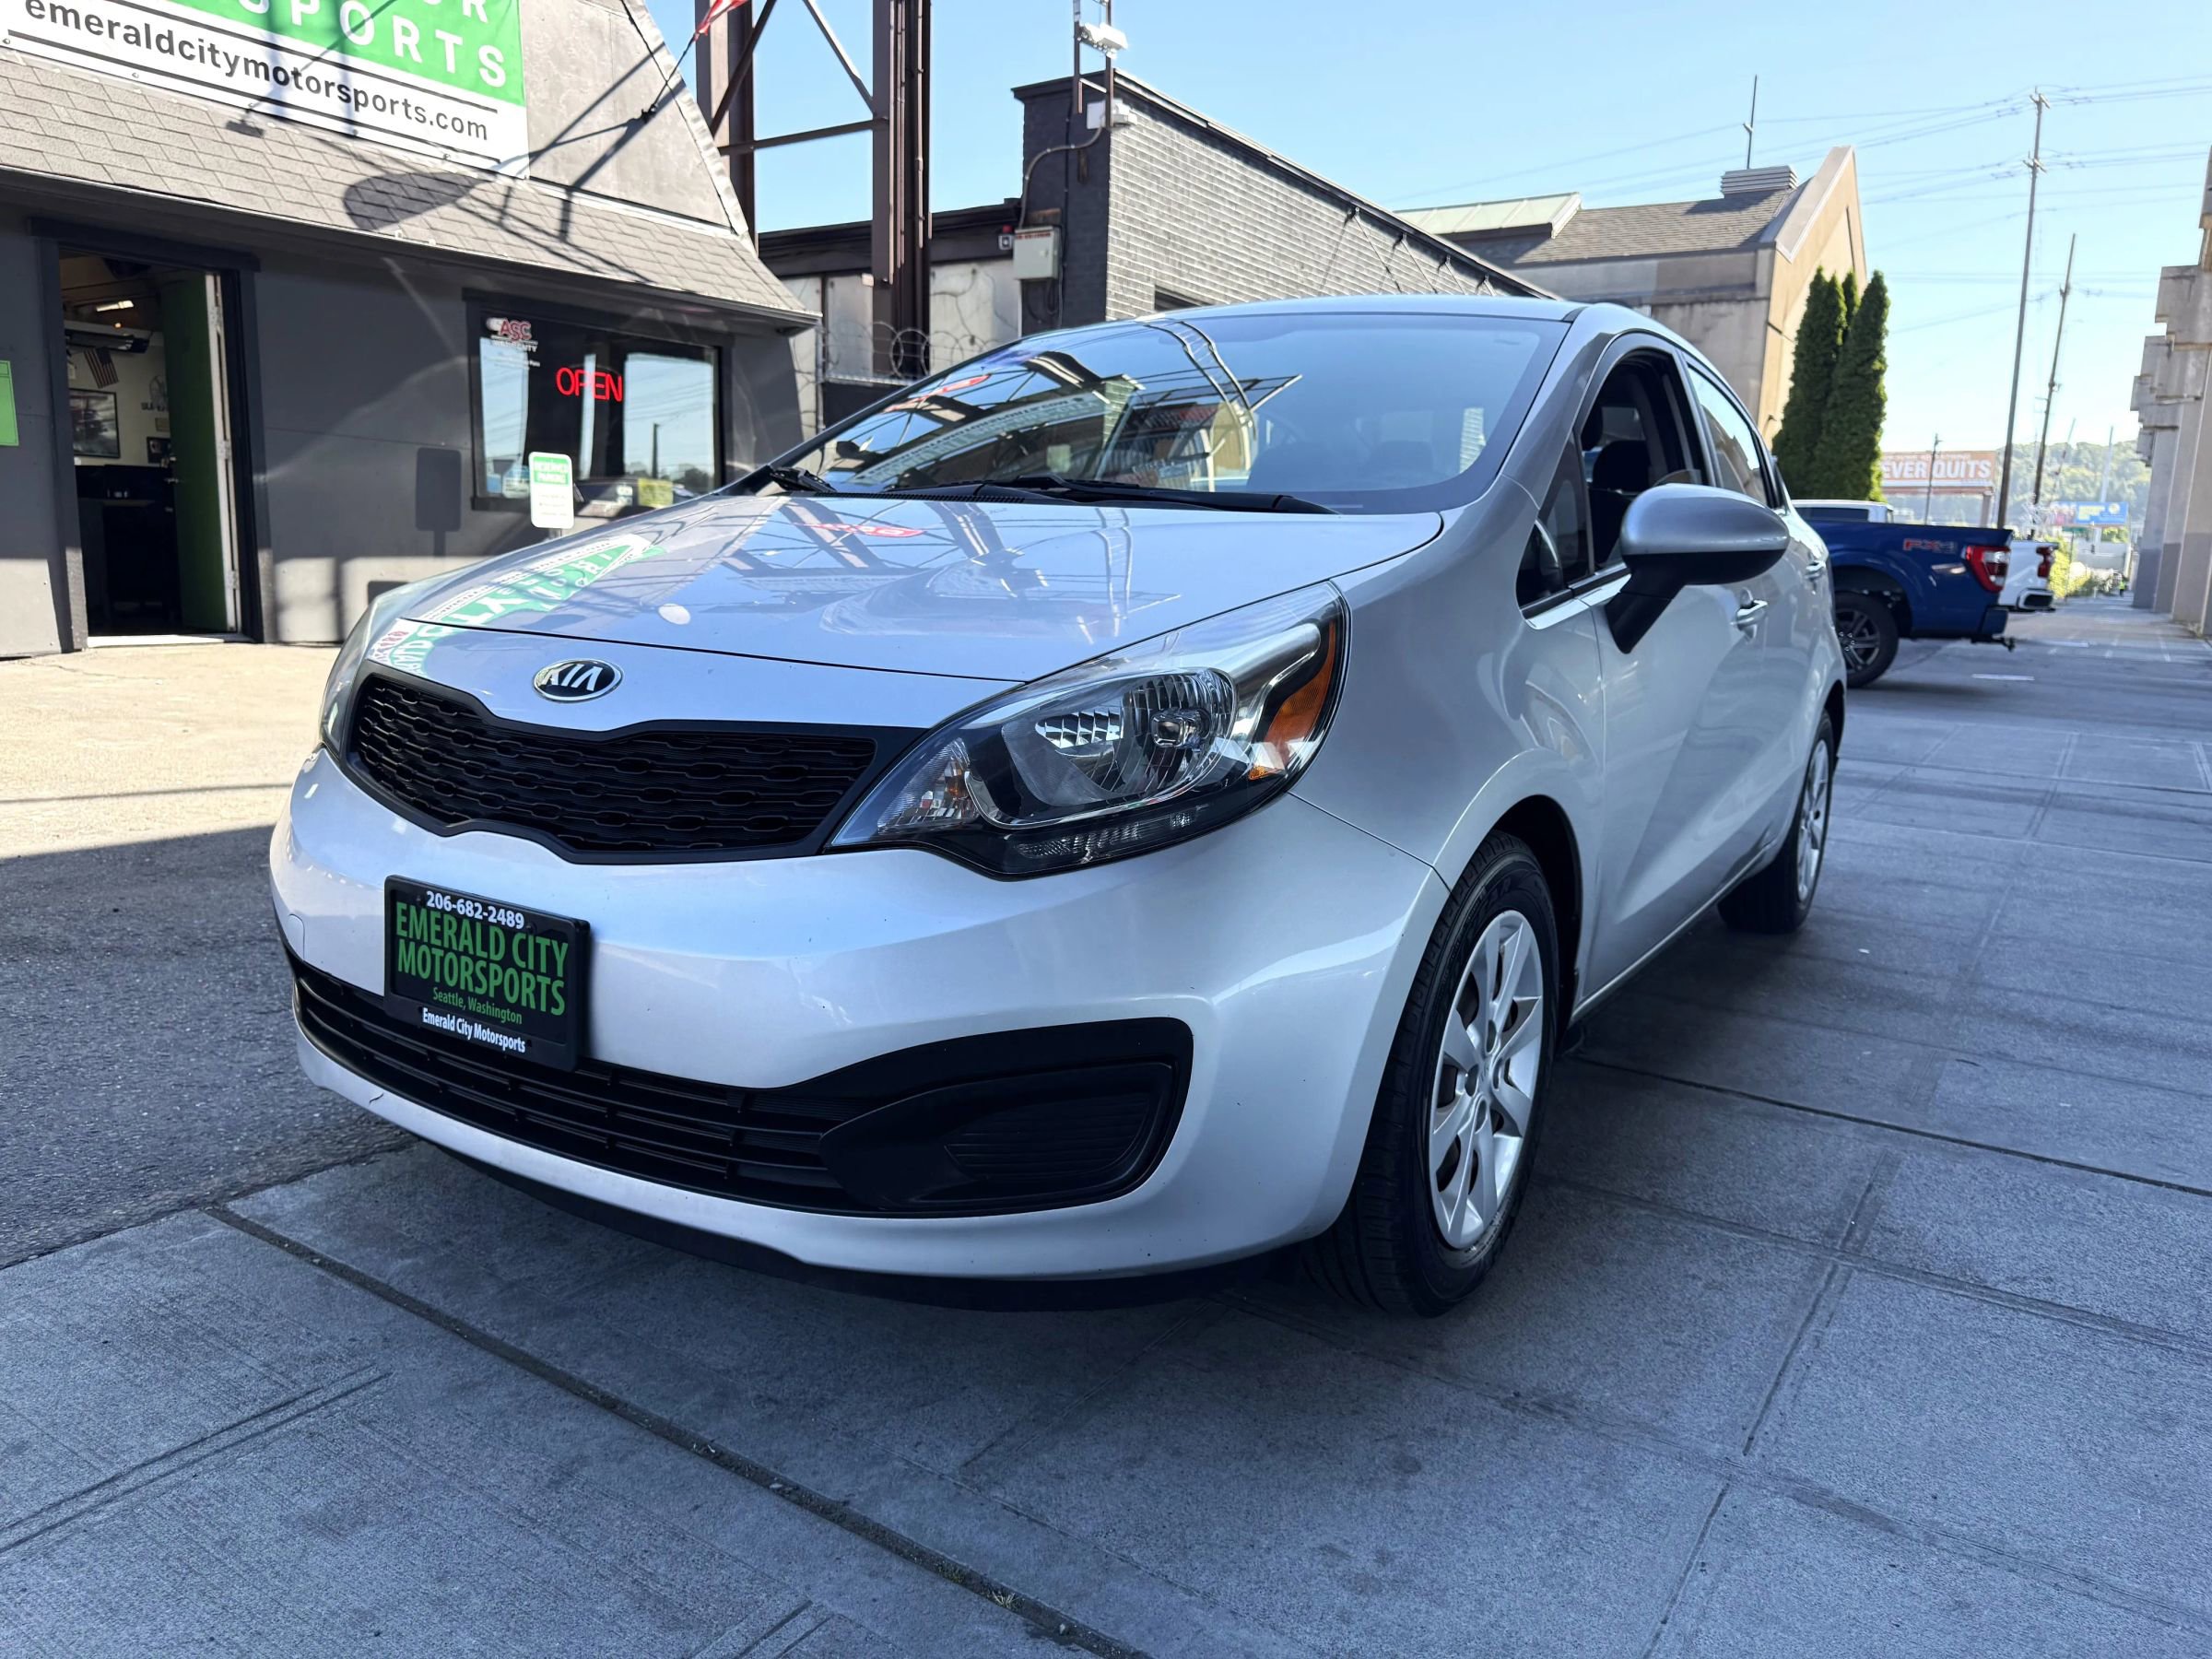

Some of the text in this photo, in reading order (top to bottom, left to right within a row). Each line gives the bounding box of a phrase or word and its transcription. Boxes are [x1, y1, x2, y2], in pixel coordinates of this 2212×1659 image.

[26, 0, 488, 141] emeraldcitymotorsports.com
[499, 318, 532, 341] ASC
[556, 367, 622, 403] OPEN
[1932, 459, 1992, 478] QUITS
[540, 664, 603, 691] KIA
[427, 890, 524, 929] 206-682-2489
[396, 902, 569, 977] EMERALD CITY
[397, 939, 565, 1016] MOTORSPORTS
[433, 987, 523, 1025] Seattle, Washington
[423, 1008, 525, 1053] Emerald City Motorsports
